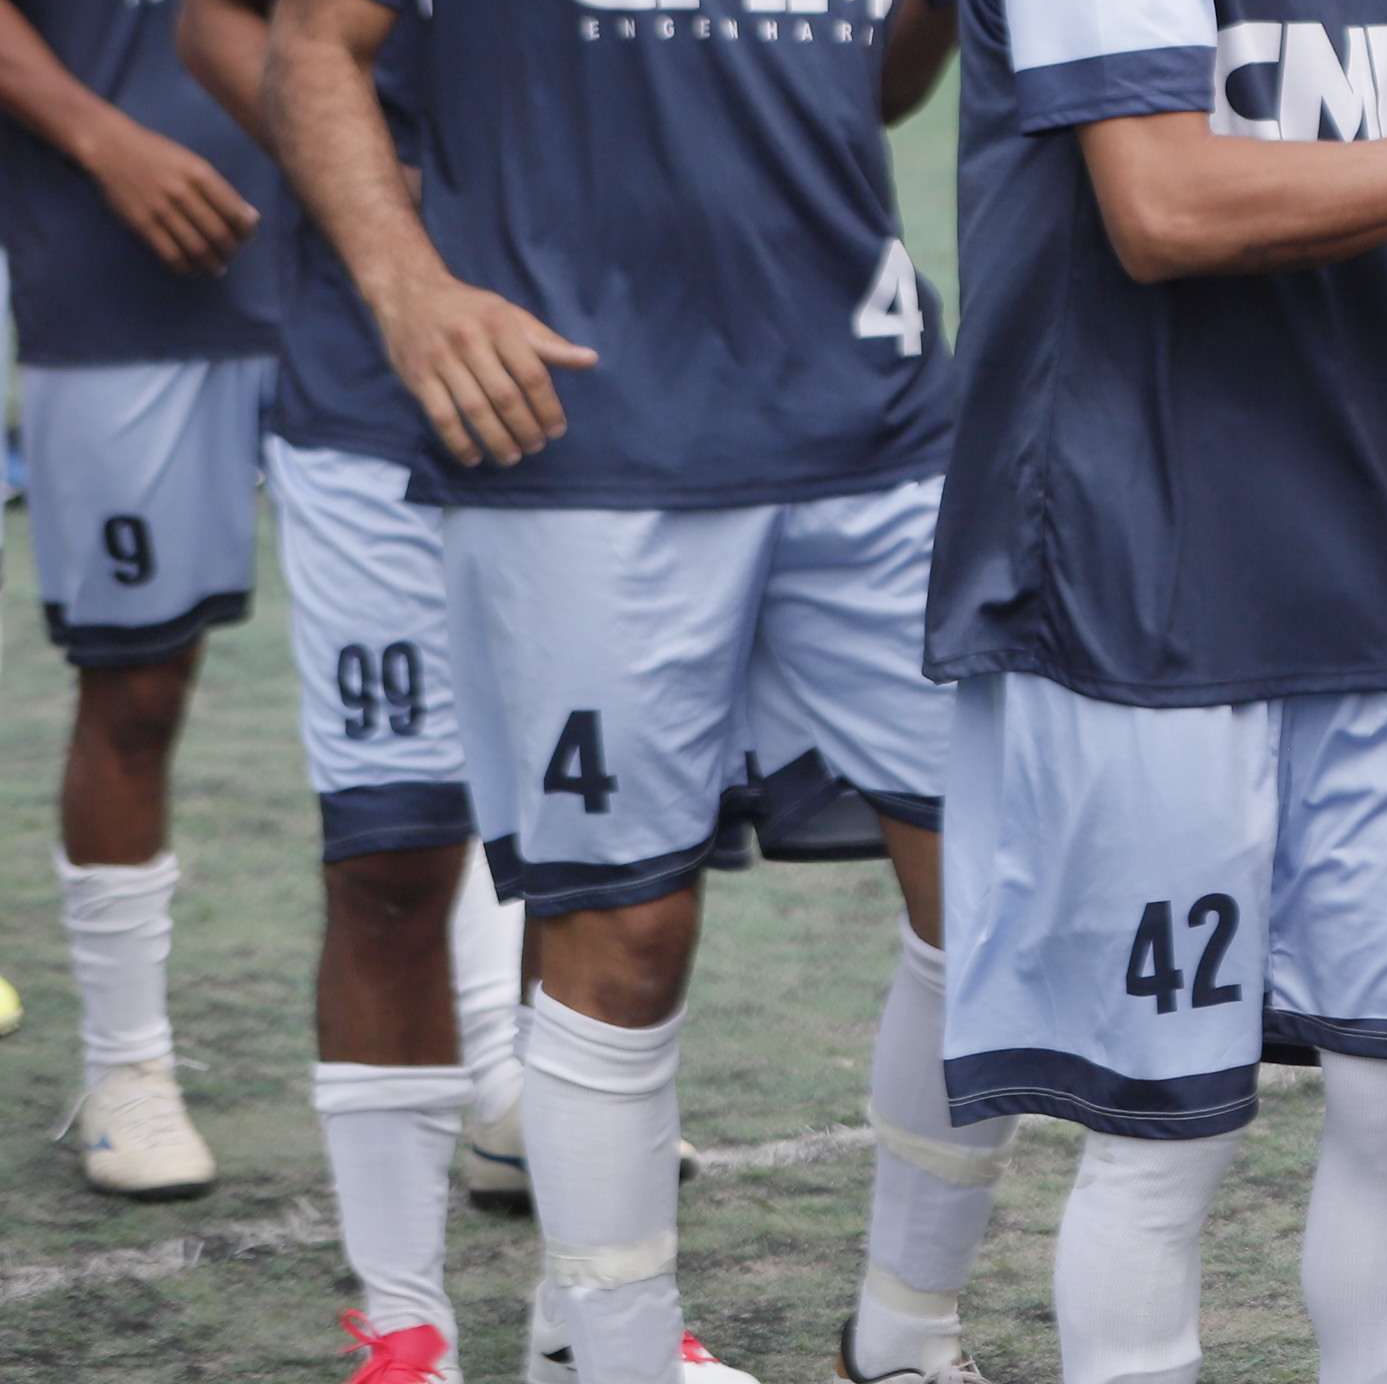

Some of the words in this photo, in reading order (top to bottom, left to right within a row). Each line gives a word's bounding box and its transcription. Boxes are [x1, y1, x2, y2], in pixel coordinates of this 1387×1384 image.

[580, 17, 875, 47] ENGENHARI
[854, 237, 924, 357] 4
[103, 514, 155, 586] 9
[336, 639, 427, 742] 99
[543, 709, 619, 816] 4
[1125, 892, 1243, 1015] 42
